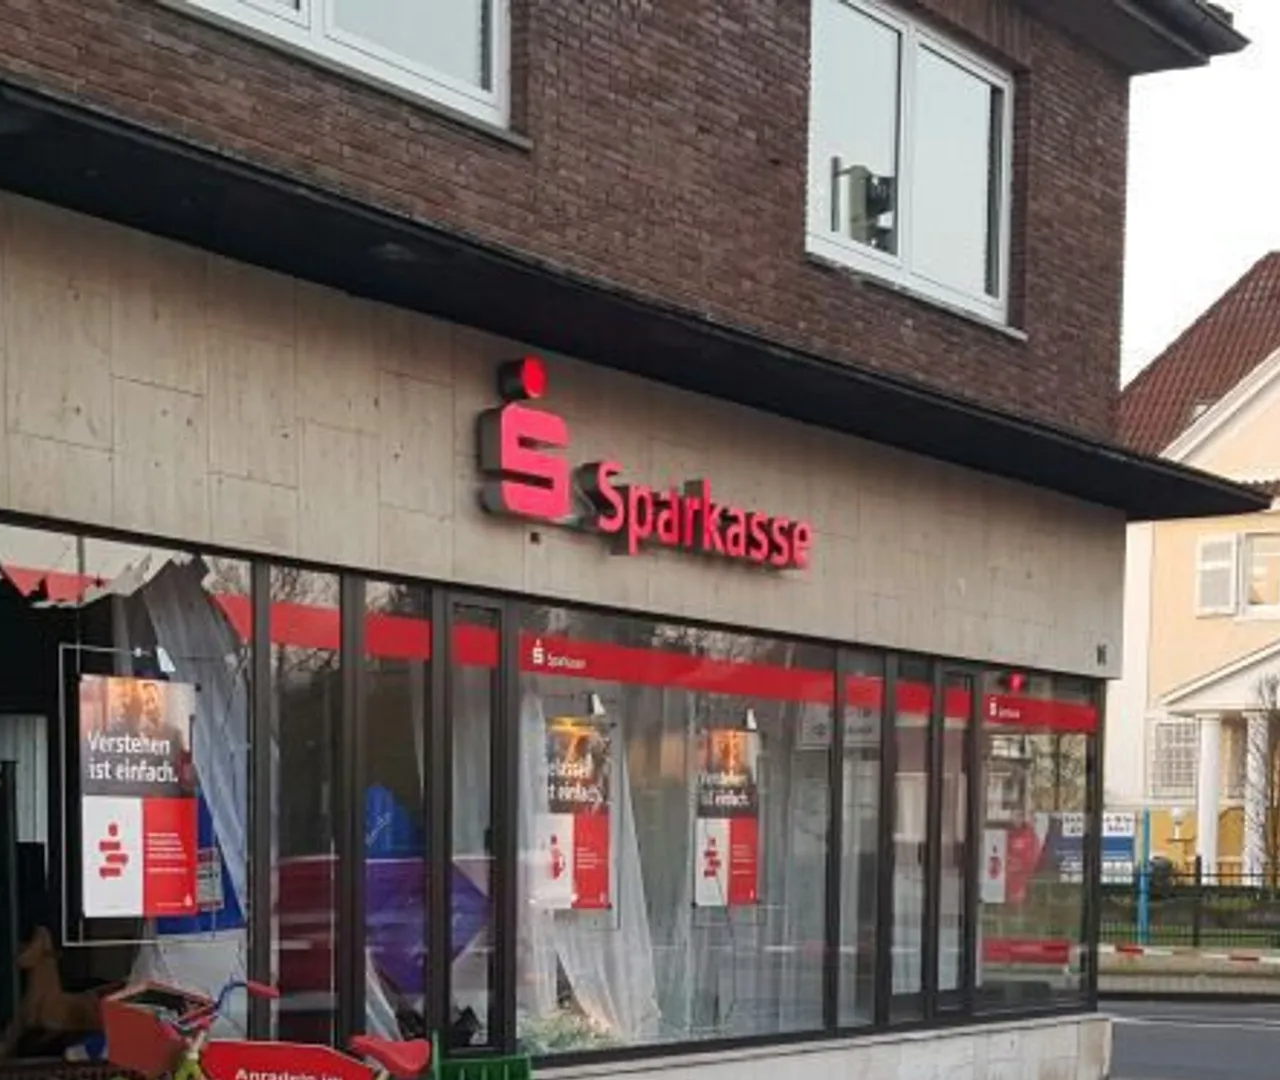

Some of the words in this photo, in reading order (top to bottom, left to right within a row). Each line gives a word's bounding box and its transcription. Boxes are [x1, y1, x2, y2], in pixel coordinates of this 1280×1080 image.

[596, 460, 813, 569] Sparkasse
[87, 731, 171, 757] Verstehen
[89, 758, 111, 780] ist
[115, 759, 178, 783] einfach.
